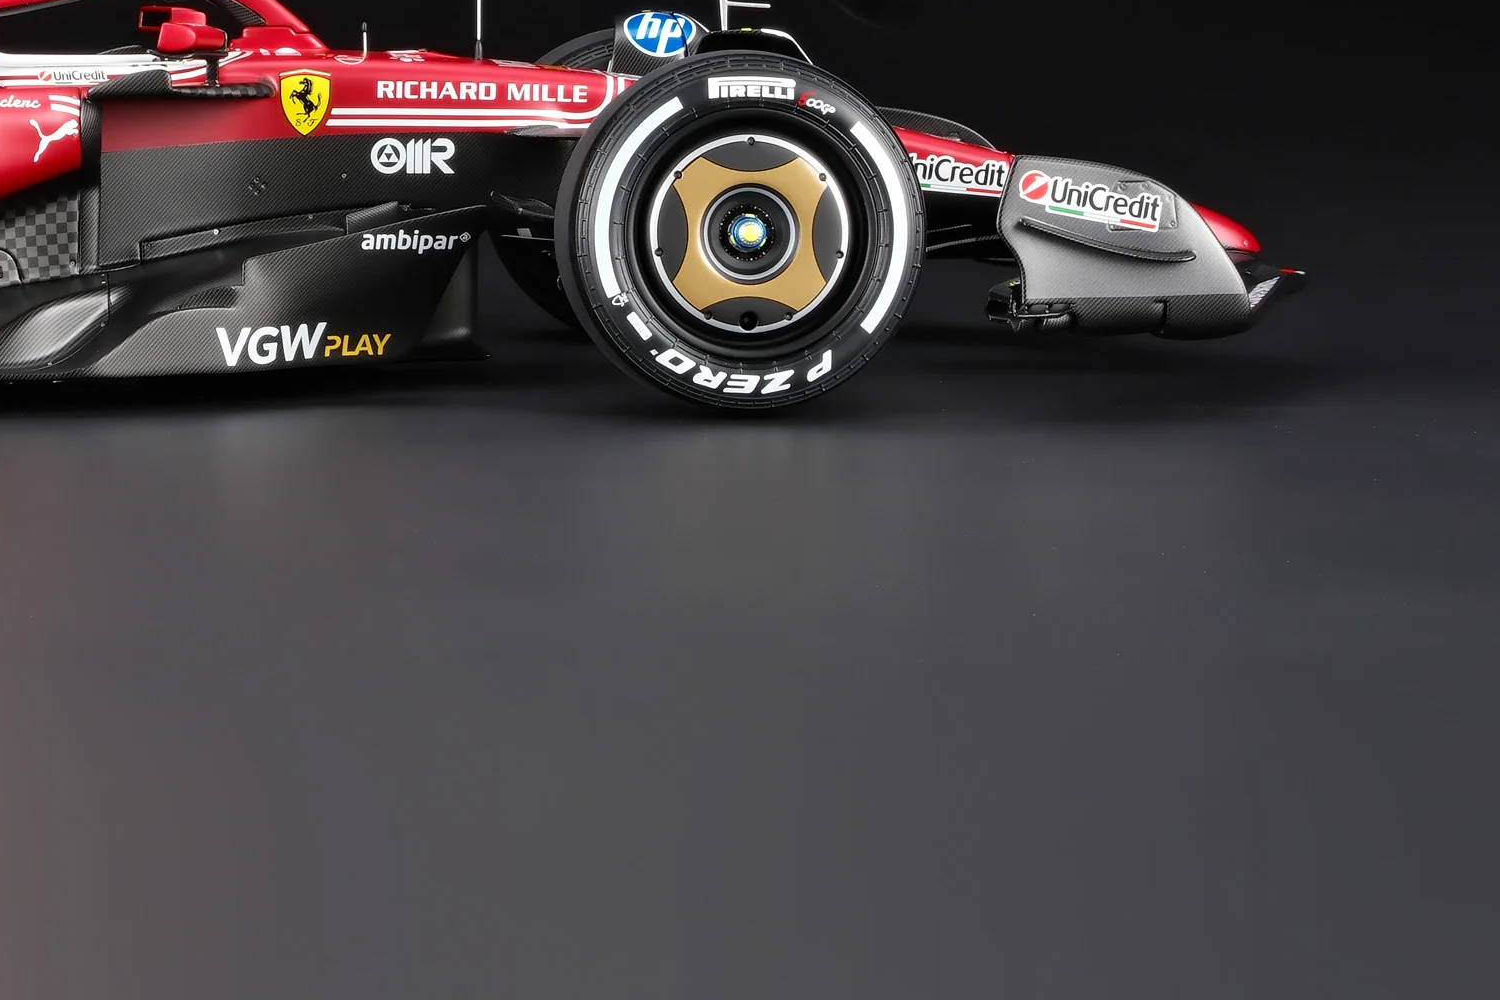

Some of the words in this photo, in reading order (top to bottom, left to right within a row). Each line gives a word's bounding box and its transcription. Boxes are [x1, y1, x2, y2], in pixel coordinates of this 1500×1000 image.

[635, 11, 686, 55] hp
[53, 70, 106, 82] UniCredit
[376, 79, 497, 101] RICHARD
[507, 83, 589, 103] MILLE
[707, 76, 797, 101] PIRELLI
[910, 154, 1006, 188] niCredit
[1051, 178, 1161, 222] UniCredit
[361, 229, 459, 255] ambipar
[215, 321, 328, 367] VGW
[324, 333, 392, 358] PLAY
[654, 348, 796, 395] ZERO
[806, 348, 833, 383] P
